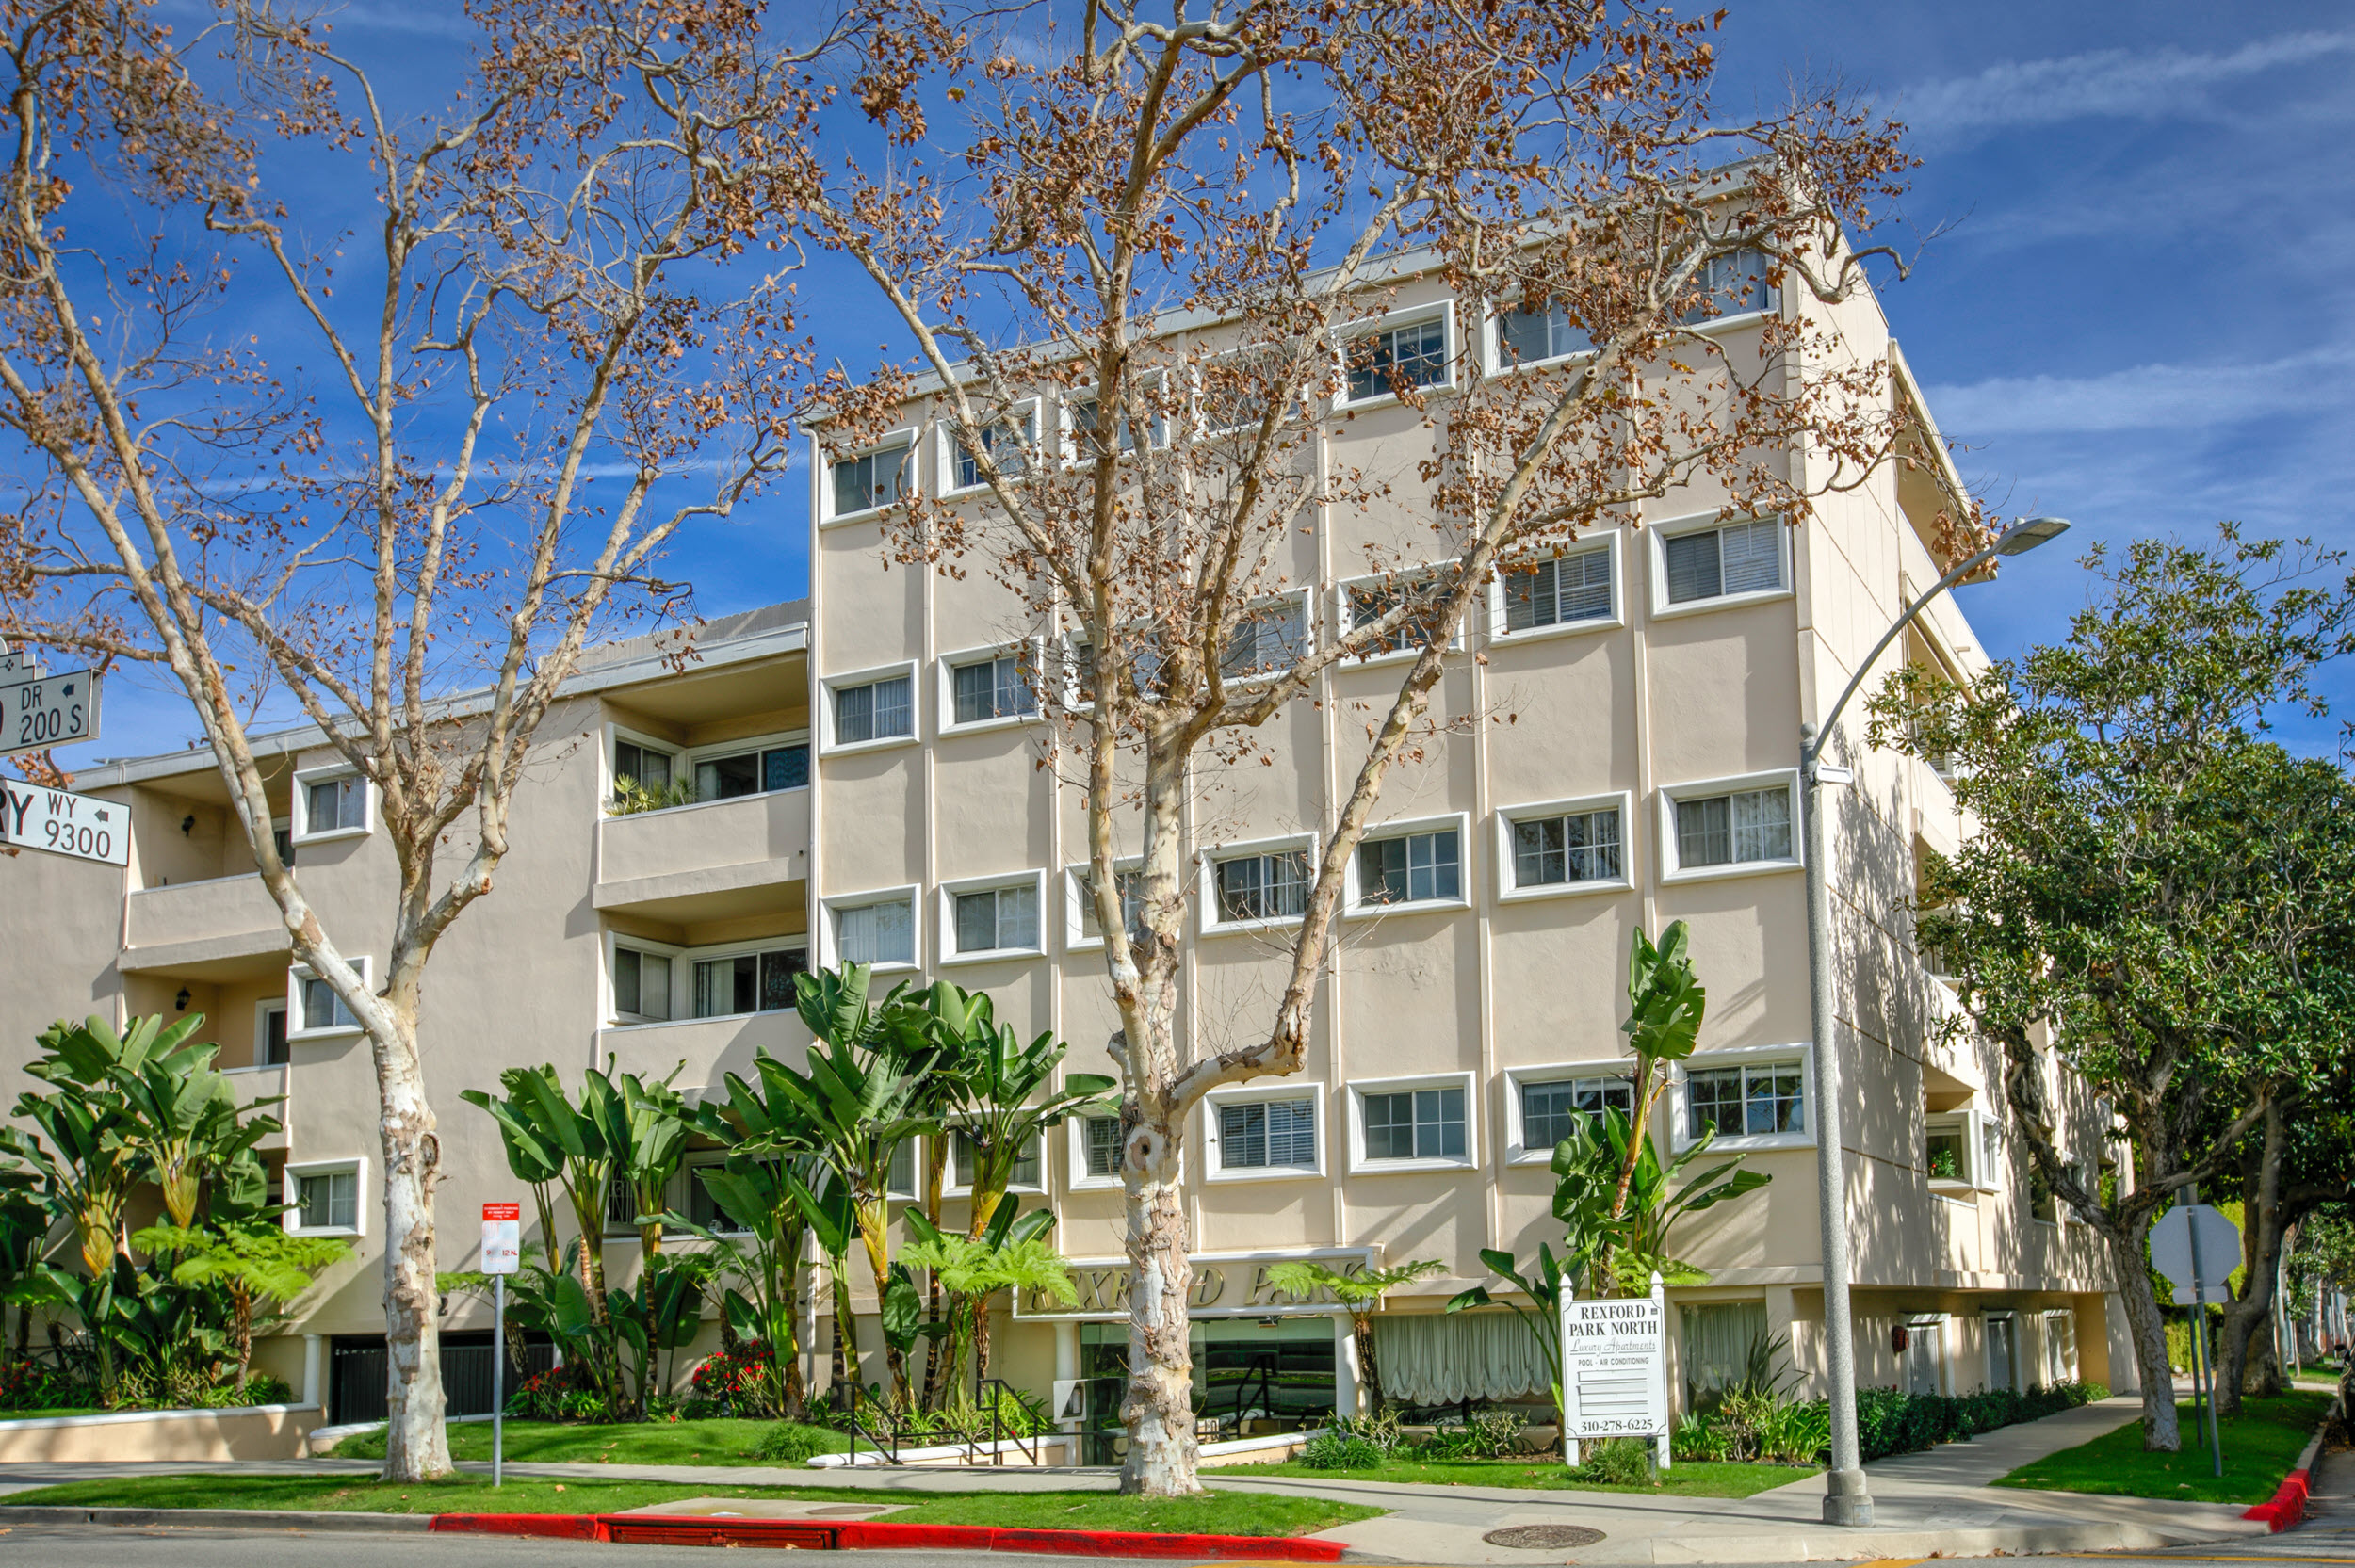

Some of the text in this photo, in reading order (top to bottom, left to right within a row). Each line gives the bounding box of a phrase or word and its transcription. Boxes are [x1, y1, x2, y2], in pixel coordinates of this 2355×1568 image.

[22, 685, 42, 710] DR
[20, 708, 61, 744] 200
[69, 704, 82, 734] S
[47, 792, 77, 818] WY
[45, 819, 110, 858] 9300
[1581, 1304, 1645, 1320] REXFORD
[1569, 1321, 1658, 1336] PARK NORTH
[1570, 1337, 1656, 1357] Luxury Apartments
[1610, 1357, 1649, 1366] CONDITIONING
[1581, 1419, 1653, 1432] 310-278-6225
